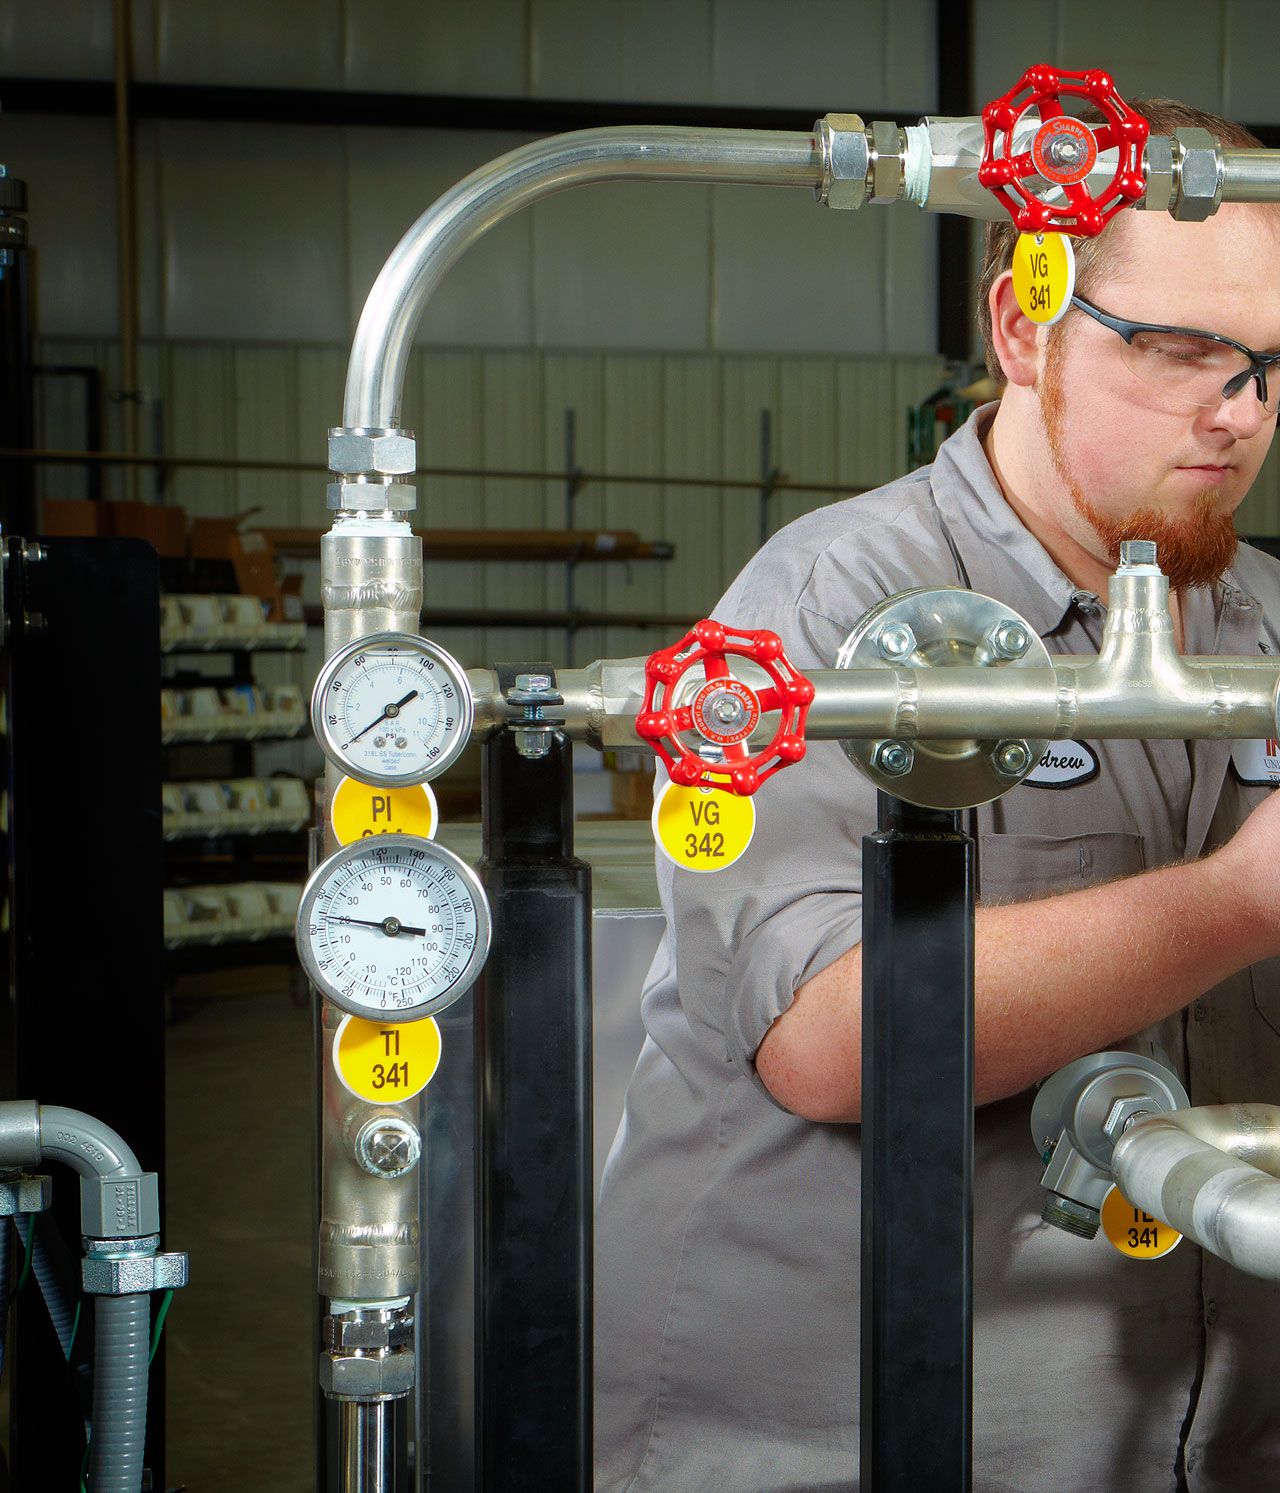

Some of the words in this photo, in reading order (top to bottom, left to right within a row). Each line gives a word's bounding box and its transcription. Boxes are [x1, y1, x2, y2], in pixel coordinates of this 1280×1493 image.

[1030, 253, 1048, 278] VG
[1029, 285, 1051, 311] 341
[354, 655, 366, 667] 60
[419, 657, 435, 670] 100
[332, 680, 342, 692] 40
[441, 683, 453, 699] 120
[696, 694, 706, 710] DISC
[328, 714, 337, 725] 20
[445, 717, 454, 731] 140
[696, 714, 707, 731] BODY
[730, 731, 747, 741] TYPE
[340, 743, 349, 751] 0
[426, 746, 440, 760] 160
[372, 796, 391, 822] PI
[690, 800, 720, 826] VG
[685, 833, 725, 858] 342
[371, 847, 388, 857] 120
[408, 849, 425, 861] 140
[441, 866, 456, 881] 160
[361, 882, 373, 892] 40
[380, 877, 392, 886] 50
[400, 879, 412, 888] 60
[417, 889, 428, 898] 70
[347, 896, 359, 906] 30
[461, 897, 473, 913] 180
[428, 905, 440, 914] 80
[309, 924, 317, 935] 60
[432, 924, 443, 934] 90
[340, 935, 351, 944] 10
[463, 934, 474, 950] 200
[421, 943, 438, 952] 100
[350, 952, 356, 961] 0
[411, 957, 428, 967] 110
[318, 960, 329, 971] 40
[361, 965, 377, 974] -10
[395, 967, 412, 976] 120
[445, 966, 460, 983] 220
[386, 975, 398, 986] °C
[342, 986, 354, 998] 20
[380, 999, 387, 1008] 0
[396, 997, 414, 1008] 250
[380, 1029, 399, 1057] TI
[371, 1061, 409, 1089] 341
[1128, 1227, 1159, 1248] 341
